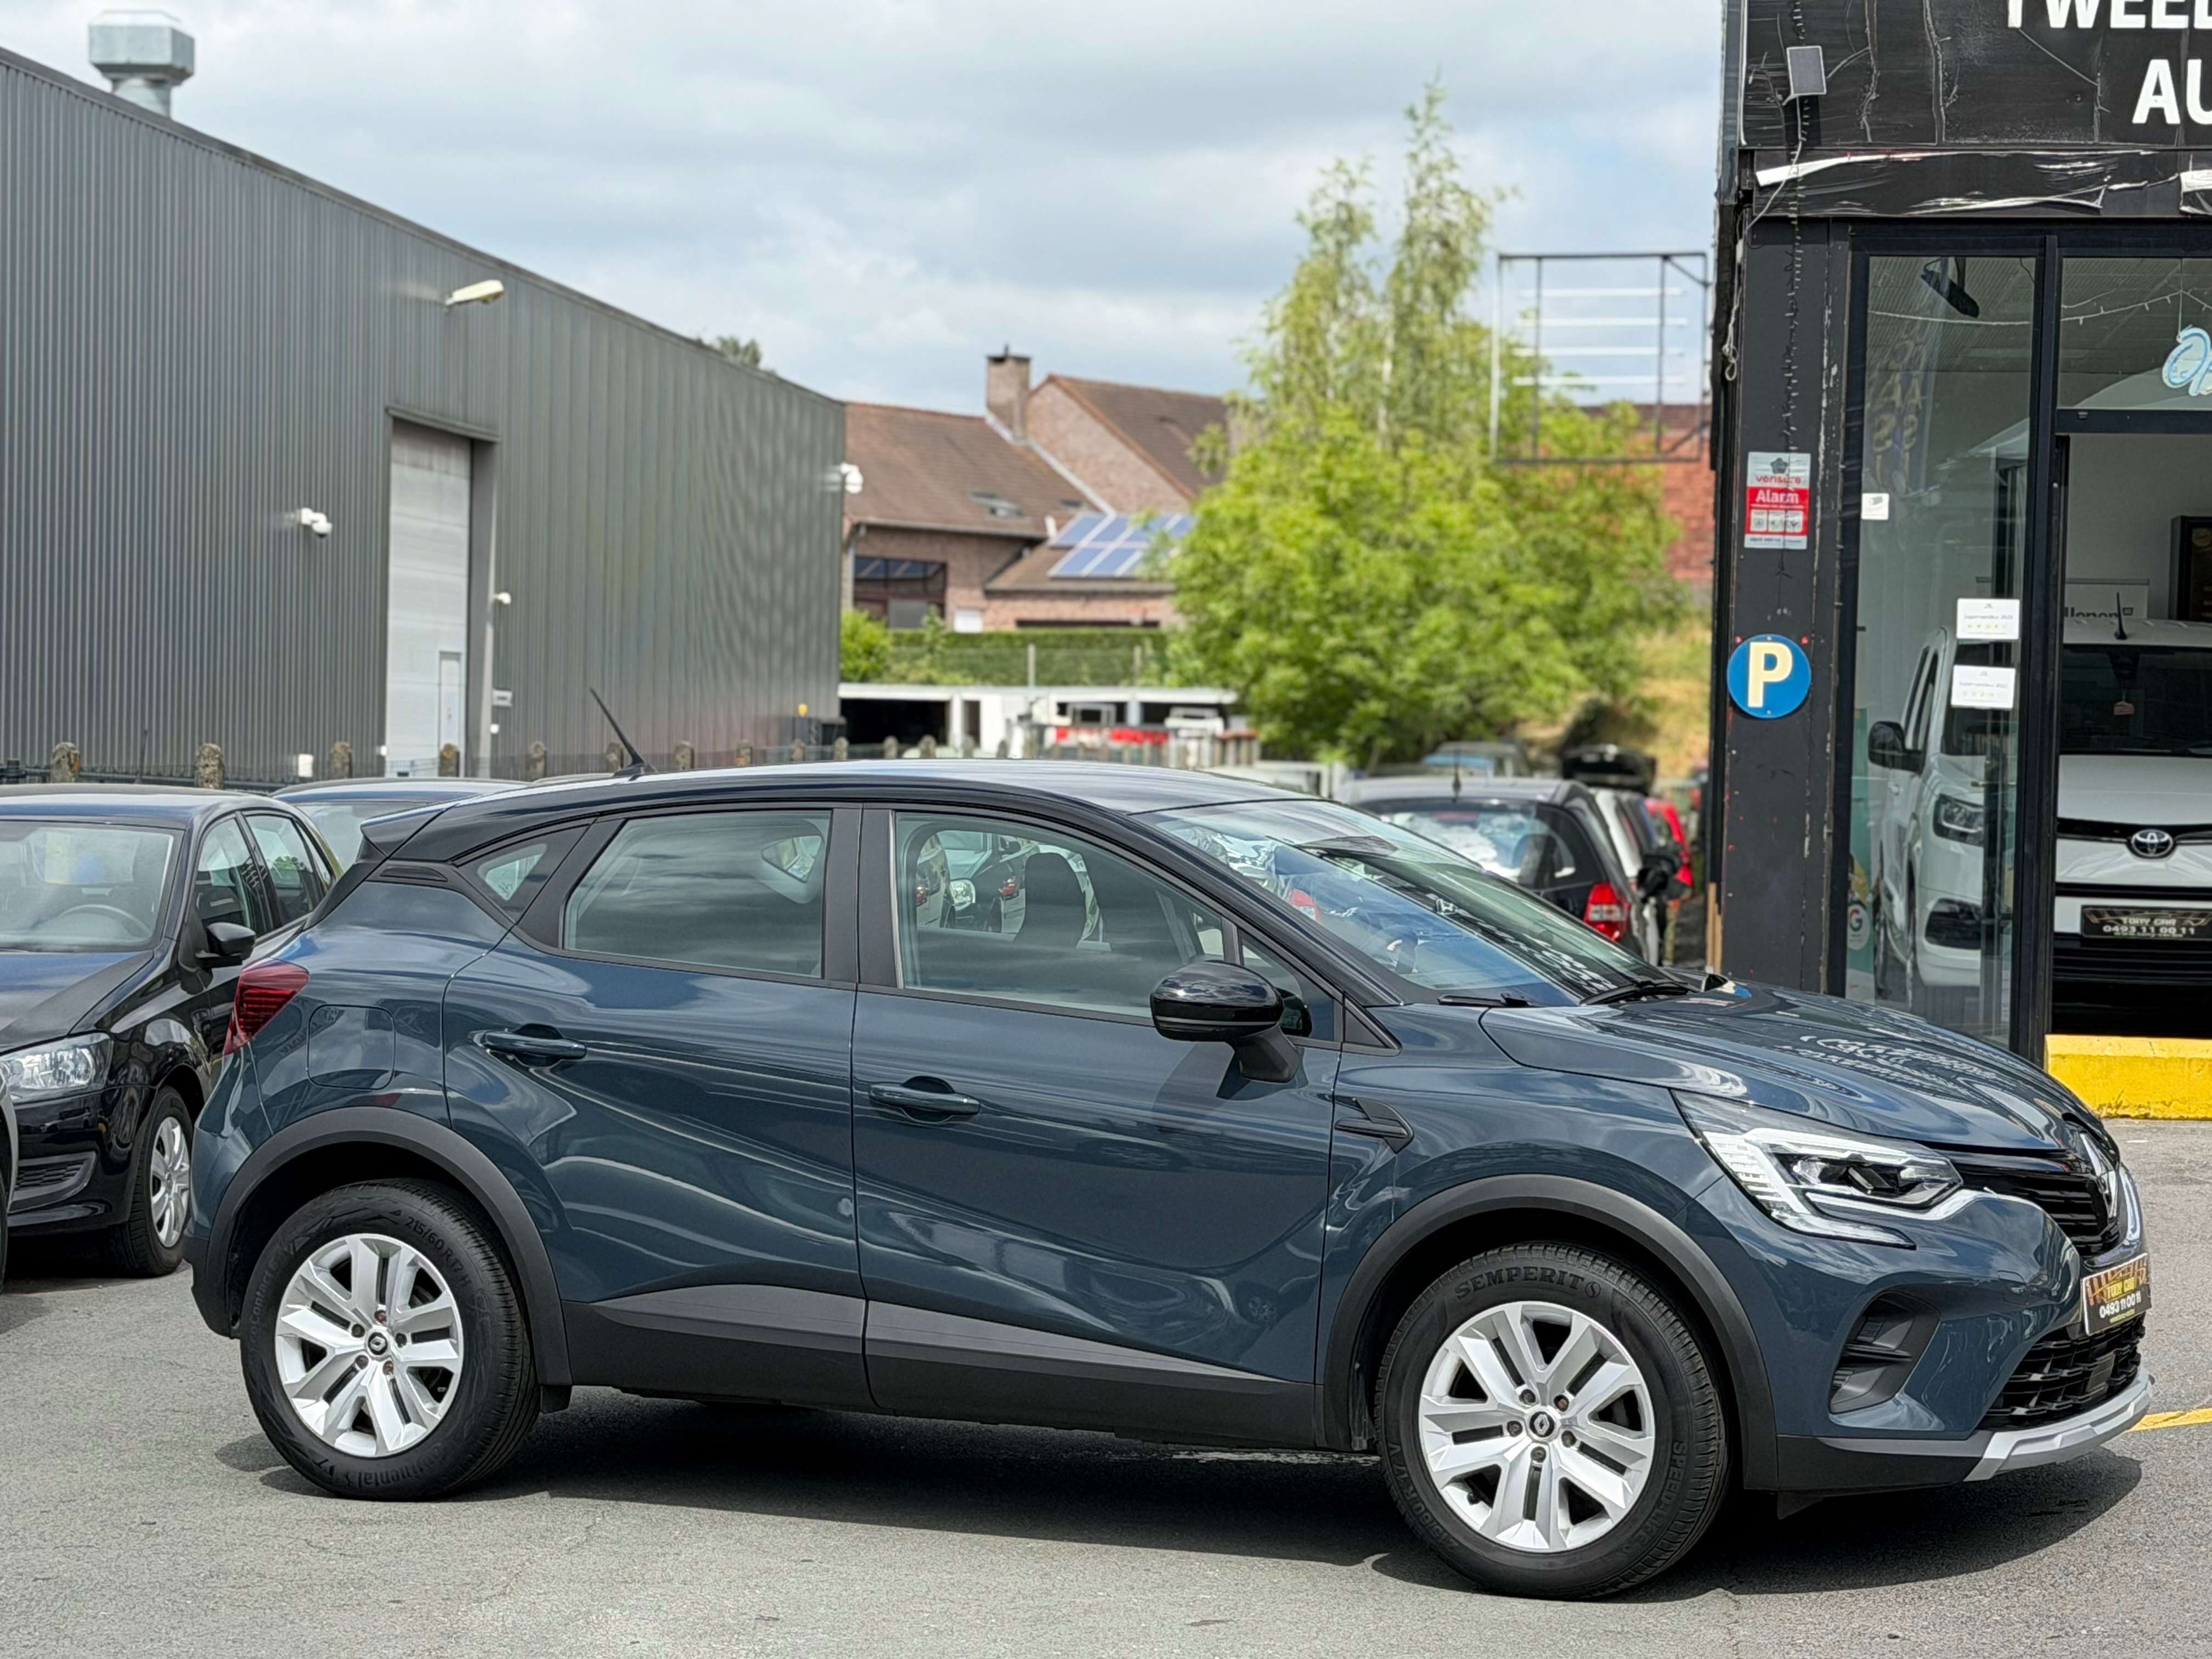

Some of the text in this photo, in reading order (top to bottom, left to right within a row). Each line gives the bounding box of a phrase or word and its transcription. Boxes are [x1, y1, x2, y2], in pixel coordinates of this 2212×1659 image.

[1756, 489, 1799, 503] Alarm
[1748, 641, 1792, 707] P
[404, 1214, 447, 1251] 215/60
[1454, 1266, 1584, 1300] SEMPERIT
